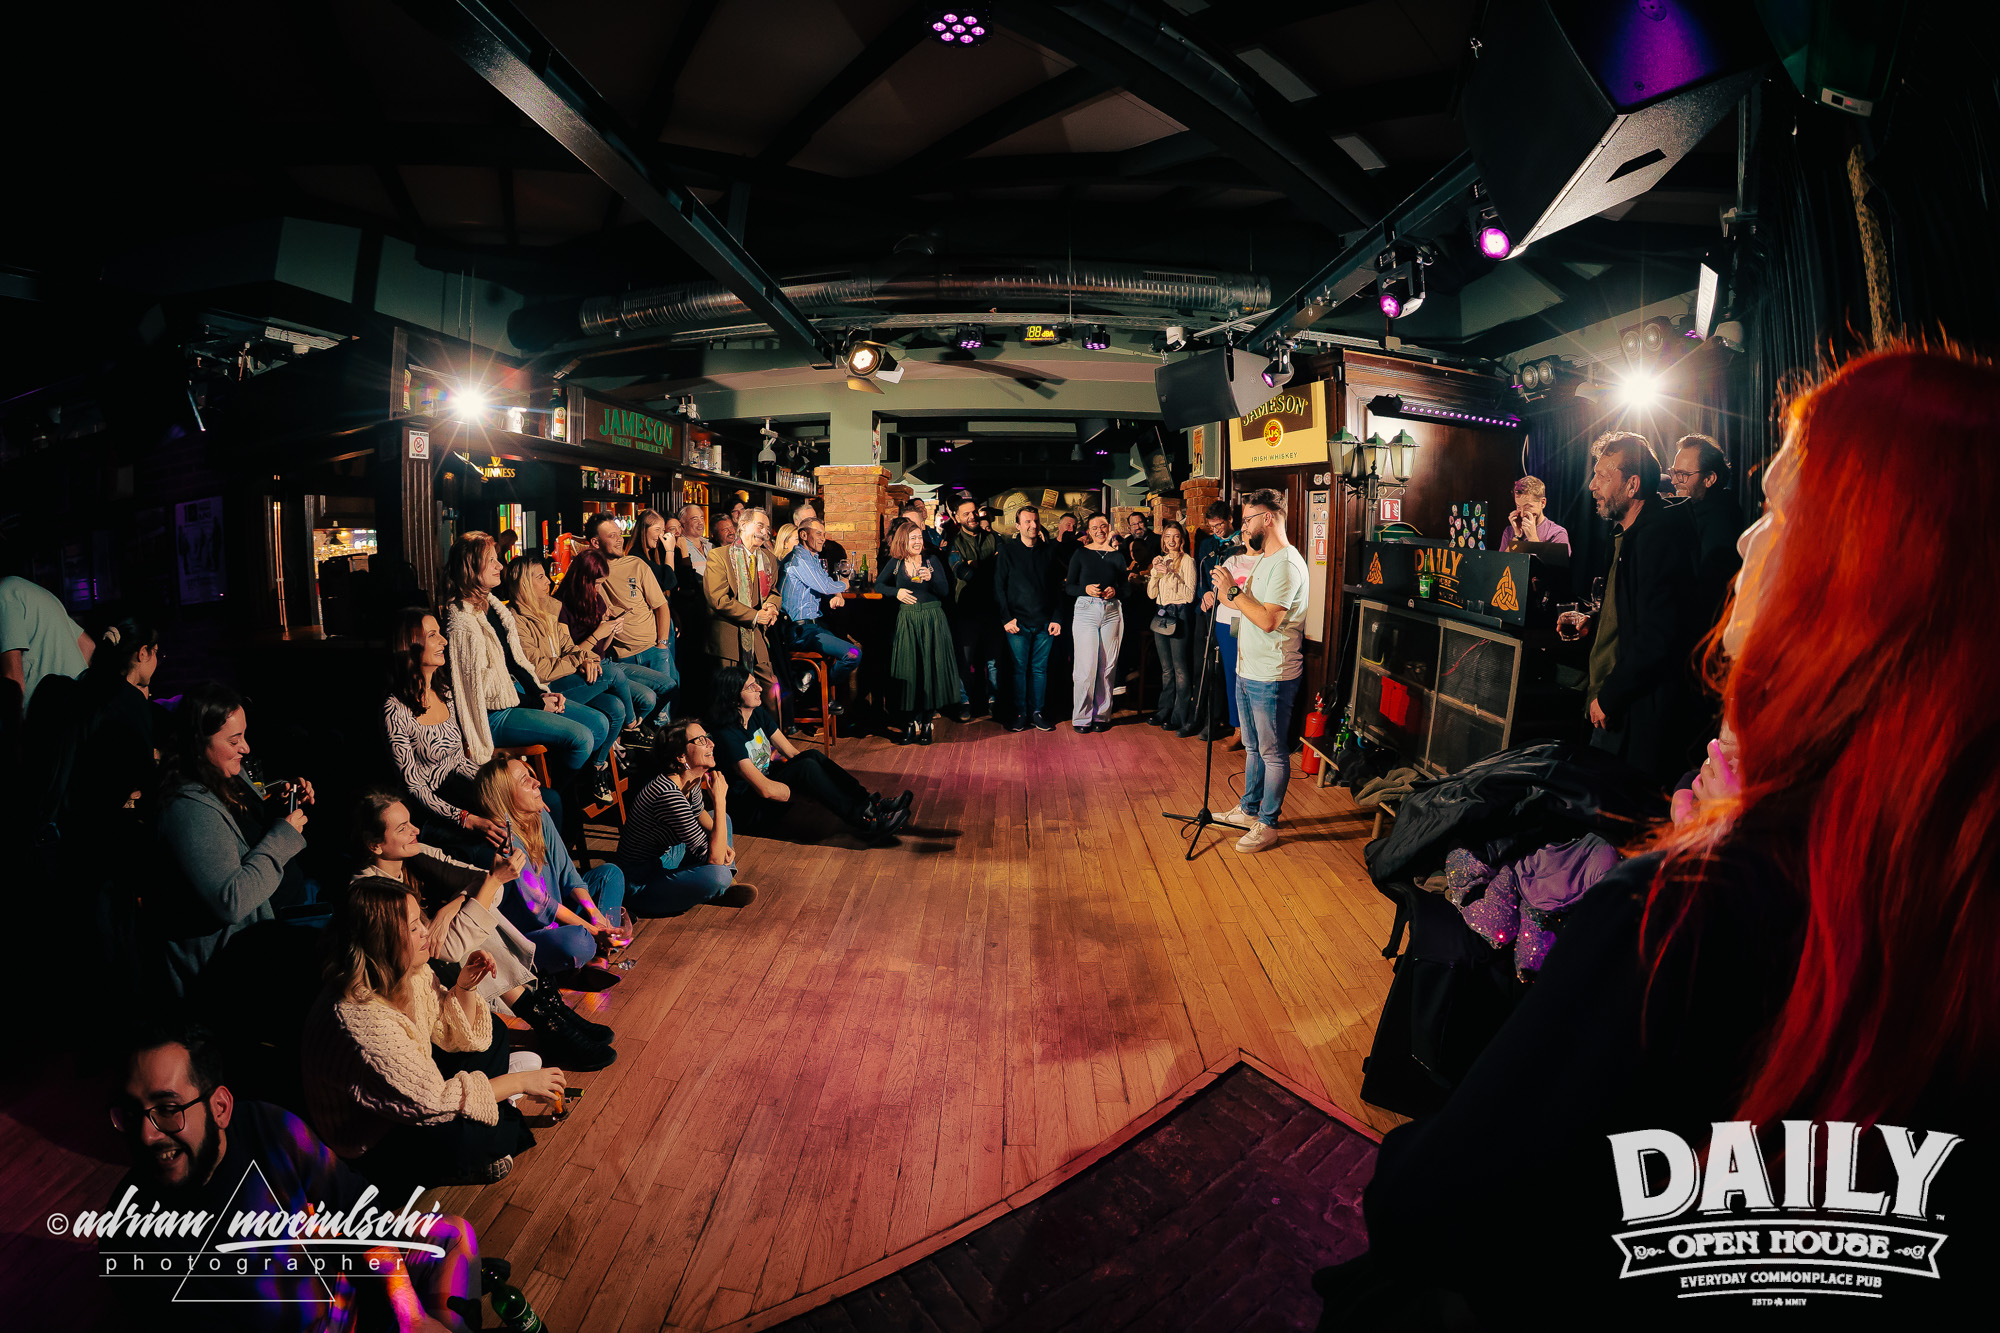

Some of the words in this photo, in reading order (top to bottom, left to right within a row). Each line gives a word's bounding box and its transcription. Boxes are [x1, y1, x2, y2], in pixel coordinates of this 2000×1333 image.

[1242, 394, 1306, 427] JAMESON
[600, 408, 674, 450] JAMESON
[612, 435, 632, 448] IRISH
[635, 441, 664, 455] WHISKEY
[1251, 454, 1268, 462] IRISH
[1269, 452, 1298, 460] WHISKEY
[1414, 548, 1463, 577] DAILY
